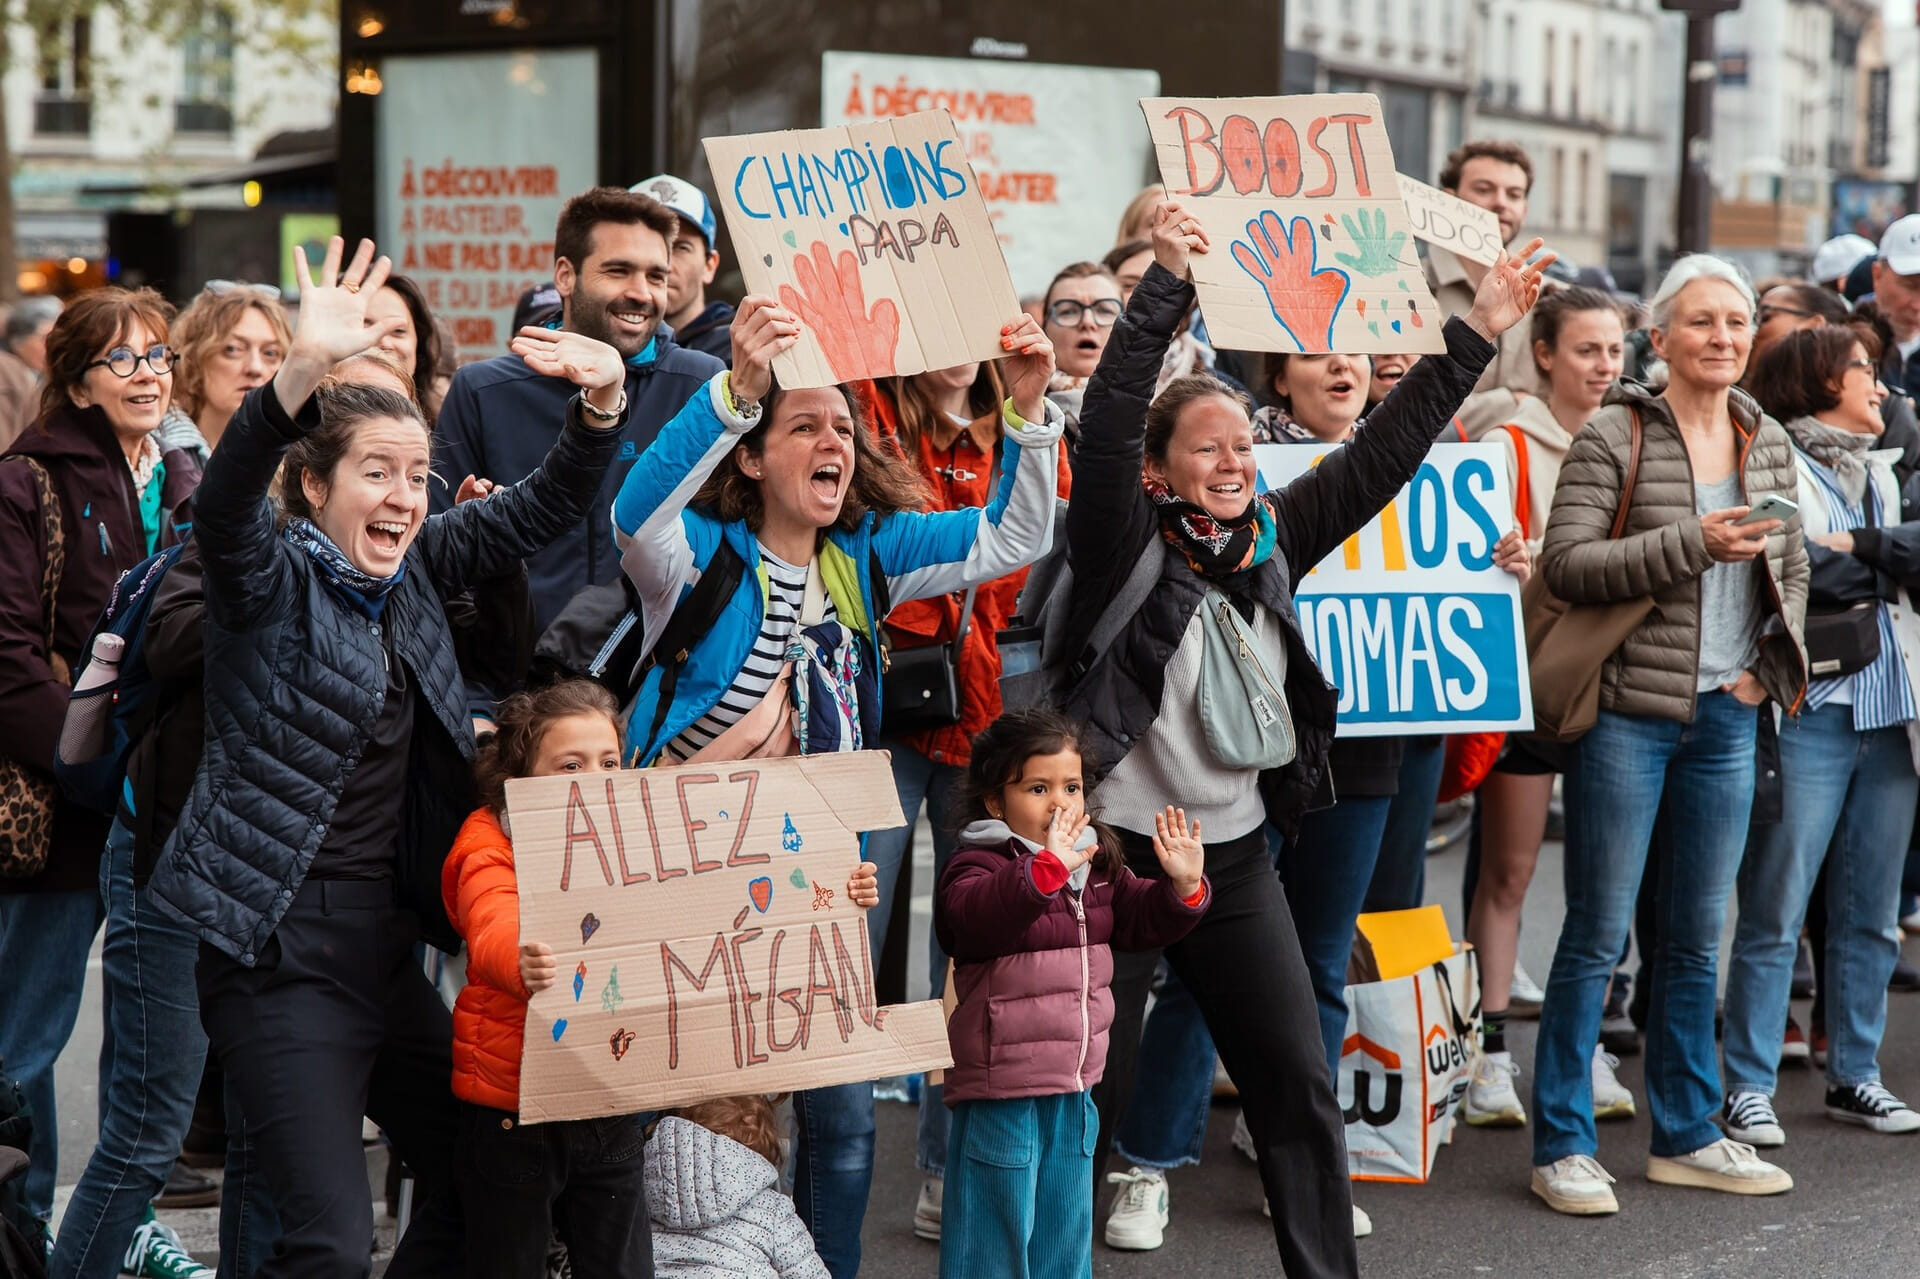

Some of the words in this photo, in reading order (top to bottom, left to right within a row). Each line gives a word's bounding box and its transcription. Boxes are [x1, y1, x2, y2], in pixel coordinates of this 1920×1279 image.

[872, 75, 1036, 126] DÉCOUVRIR
[422, 156, 559, 198] DÉCOUVRIR
[734, 140, 967, 219] CHAMPIONS
[1164, 106, 1373, 198] BOOST
[424, 243, 455, 272] NE
[461, 243, 501, 273] PAS
[849, 211, 961, 267] PAPA
[1404, 199, 1501, 262] UDOS
[560, 770, 771, 892] ALLEZ
